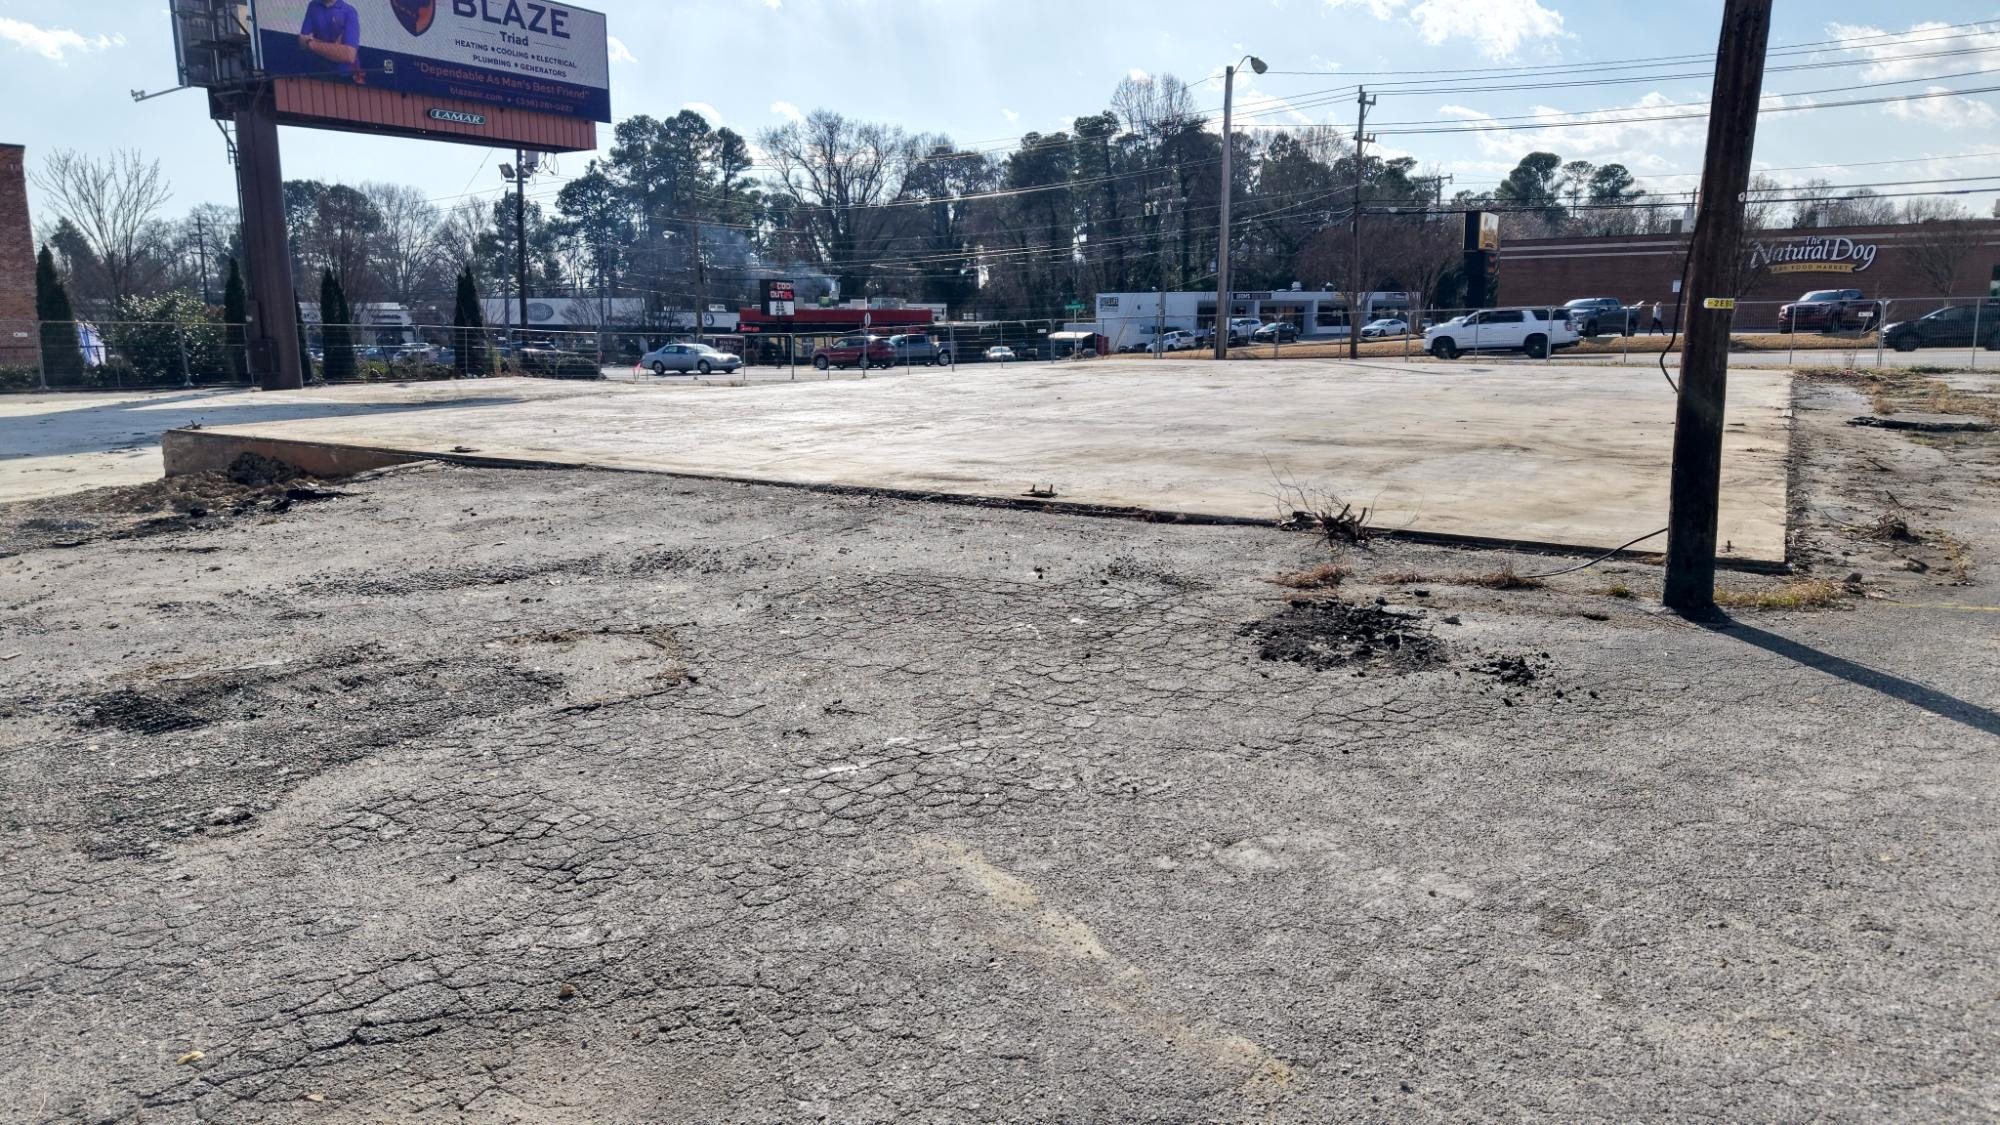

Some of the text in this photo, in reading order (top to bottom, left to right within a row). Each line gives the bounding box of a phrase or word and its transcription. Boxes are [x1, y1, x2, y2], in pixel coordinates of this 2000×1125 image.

[452, 0, 570, 39] BLAZE
[500, 31, 529, 46] Triad
[455, 39, 577, 69] HEATING COOLING ELECTRICAL
[473, 54, 567, 78] PLUMBING GENERATORS
[486, 74, 500, 85] As
[502, 77, 531, 90] Man's
[532, 82, 554, 94] Best
[435, 110, 482, 123] LAMAR
[1806, 235, 1822, 245] The
[1750, 237, 1877, 272] Natural Dog
